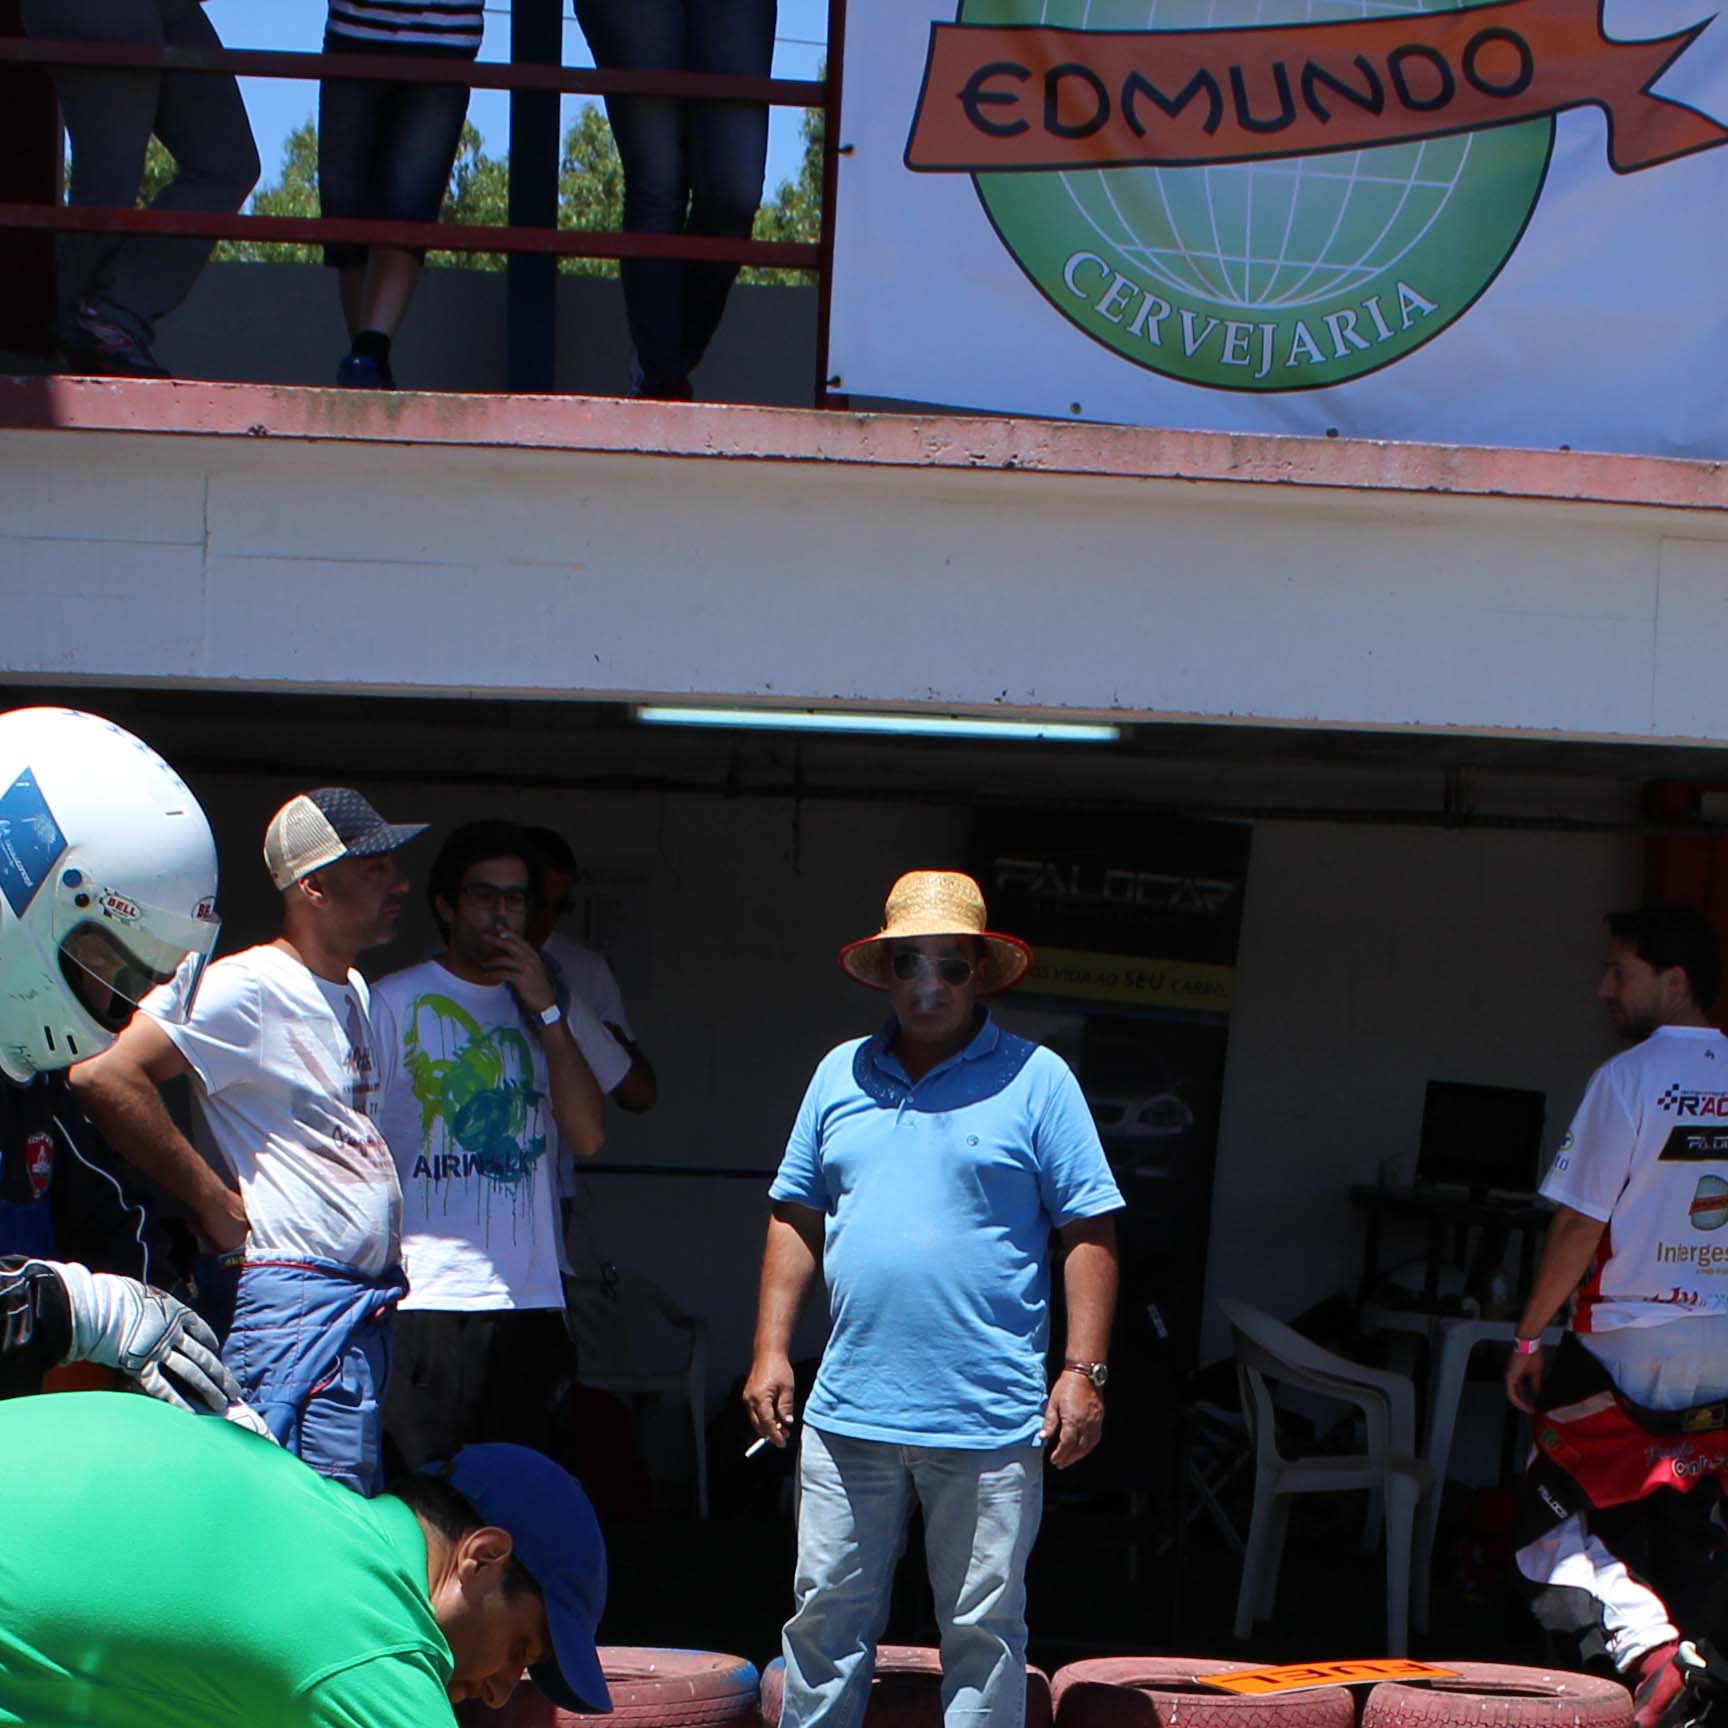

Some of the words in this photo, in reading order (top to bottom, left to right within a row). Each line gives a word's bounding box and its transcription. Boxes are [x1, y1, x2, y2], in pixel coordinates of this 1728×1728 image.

[958, 26, 1534, 139] EDMUNDO
[1060, 249, 1440, 379] CERVEJARIA
[106, 898, 137, 918] BELL
[1122, 965, 1166, 992] SEU
[1222, 1662, 1434, 1685] FUEL
